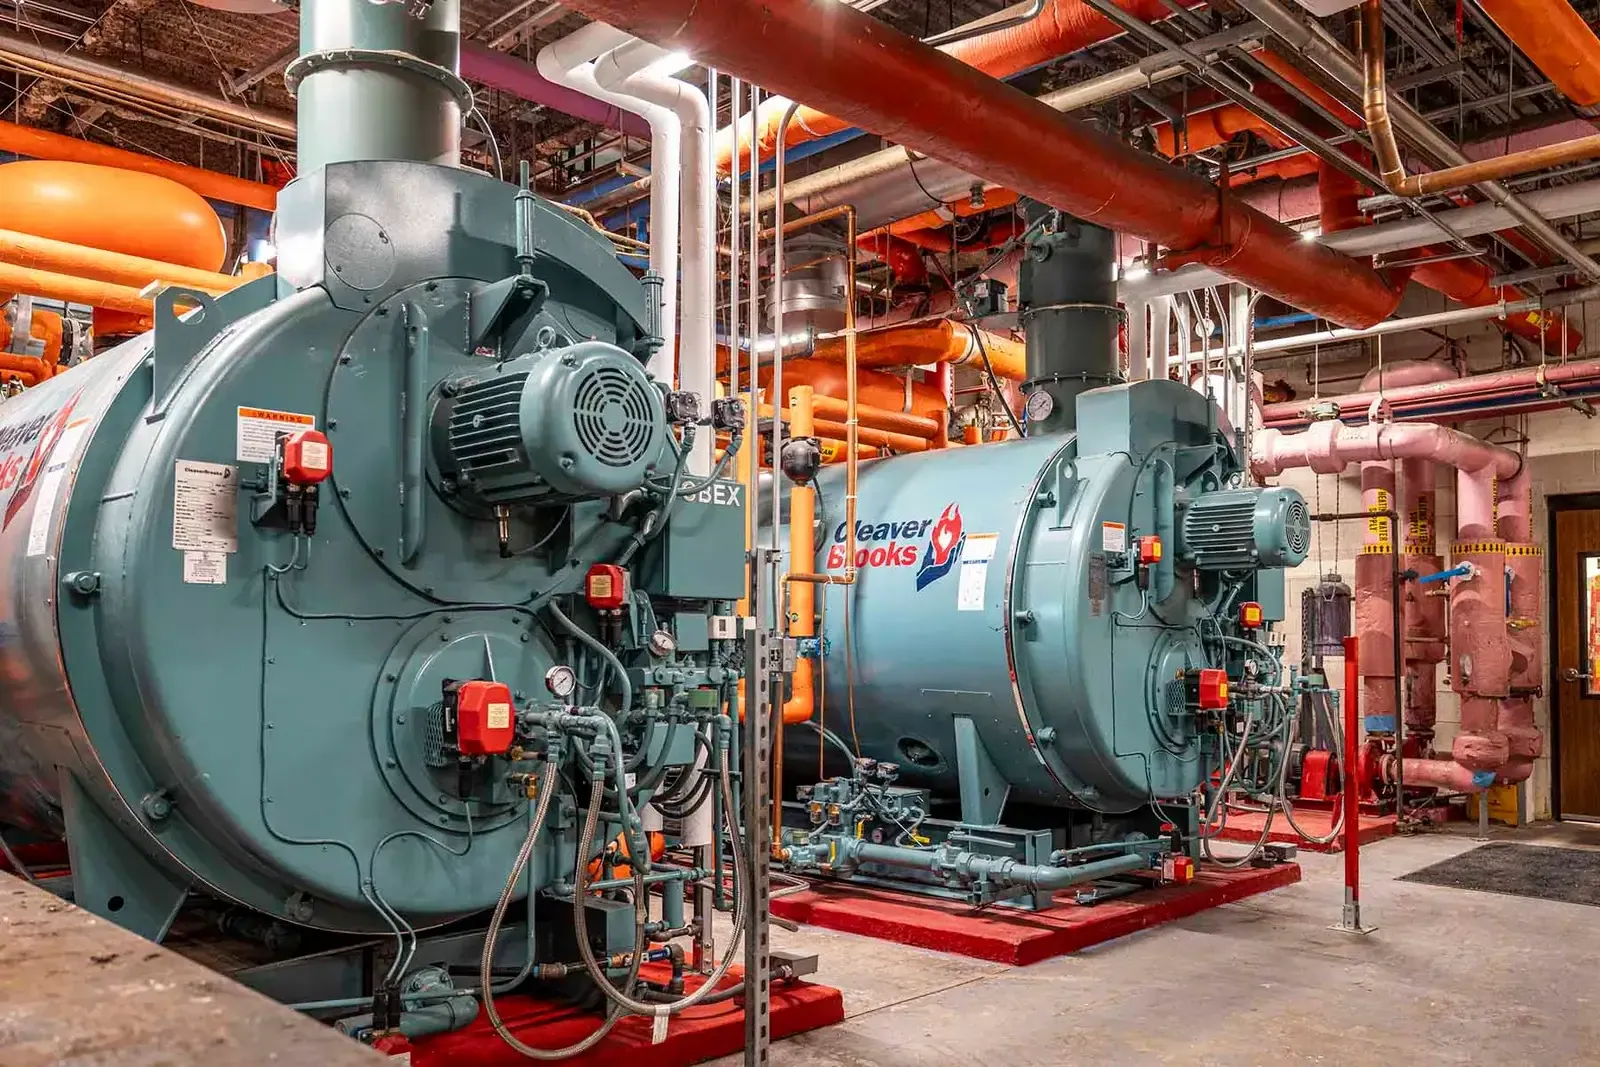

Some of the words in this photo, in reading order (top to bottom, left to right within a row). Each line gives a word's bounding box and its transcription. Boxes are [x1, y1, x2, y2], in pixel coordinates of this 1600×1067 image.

[258, 411, 303, 424] WARNING
[1369, 507, 1378, 531] SPPLY
[1379, 521, 1388, 541] WATER
[827, 541, 918, 569] Books
